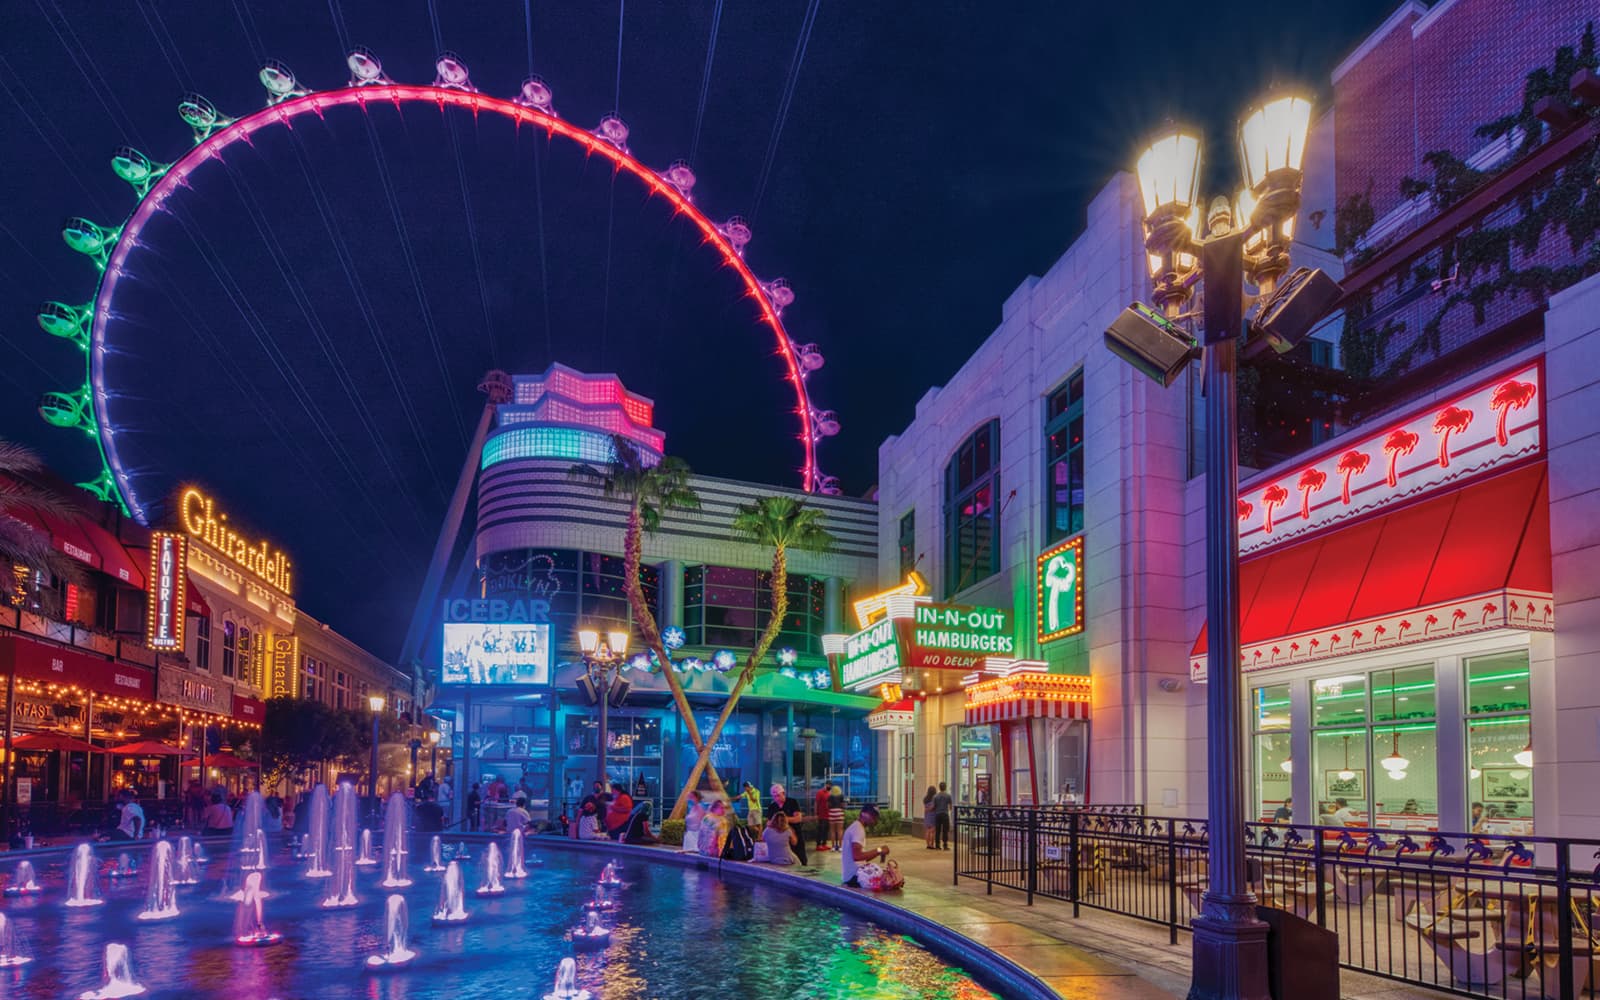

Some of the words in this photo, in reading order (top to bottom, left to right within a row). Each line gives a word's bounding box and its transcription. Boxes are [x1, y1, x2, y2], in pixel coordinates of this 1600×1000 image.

[183, 490, 291, 595] Ghirardelli
[160, 537, 172, 639] FAVORITE
[443, 598, 551, 622] ICEBAR
[916, 607, 1005, 630] IN-N-OUT
[916, 630, 1014, 653] HAMBURGERS
[52, 658, 64, 672] BAR
[922, 655, 941, 665] NO
[943, 656, 978, 667] DELAY
[182, 679, 216, 704] FAVORITE
[15, 701, 50, 719] KFAST
